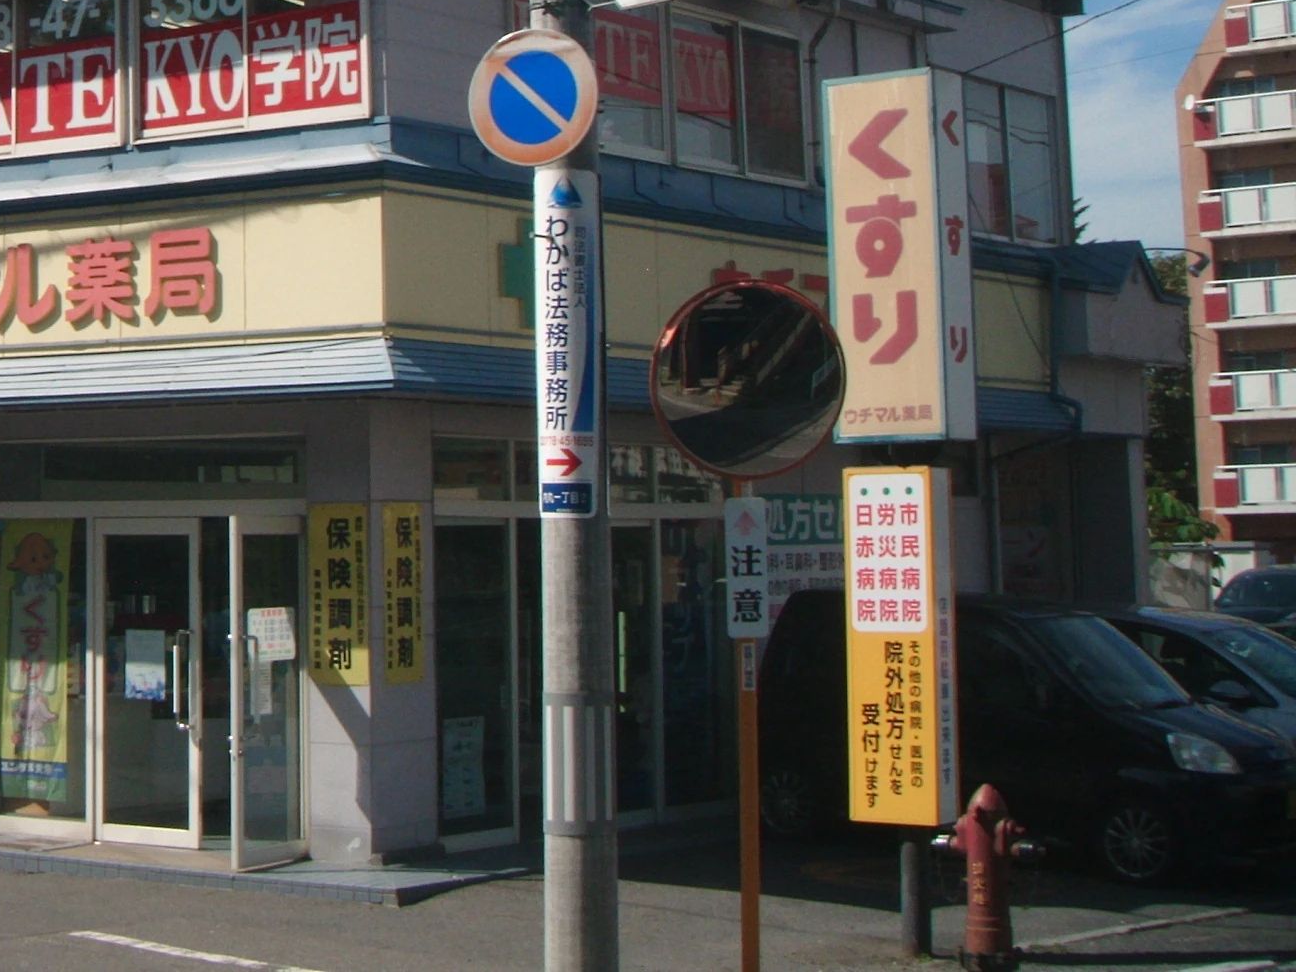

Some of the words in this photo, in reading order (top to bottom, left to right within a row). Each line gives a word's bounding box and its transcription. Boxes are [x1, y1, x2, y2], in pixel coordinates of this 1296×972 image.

[845, 107, 919, 365] くすり
[941, 109, 967, 363] くすり
[545, 215, 569, 430] わかば法務事務所
[844, 403, 933, 426] ウチマル薬局
[731, 544, 762, 623] 注意
[856, 504, 876, 622] 日赤病院
[877, 503, 898, 622] 労災病院
[899, 502, 921, 622] 市民病院
[862, 703, 881, 808] 受付けます
[884, 641, 905, 795] 院外処方せんを
